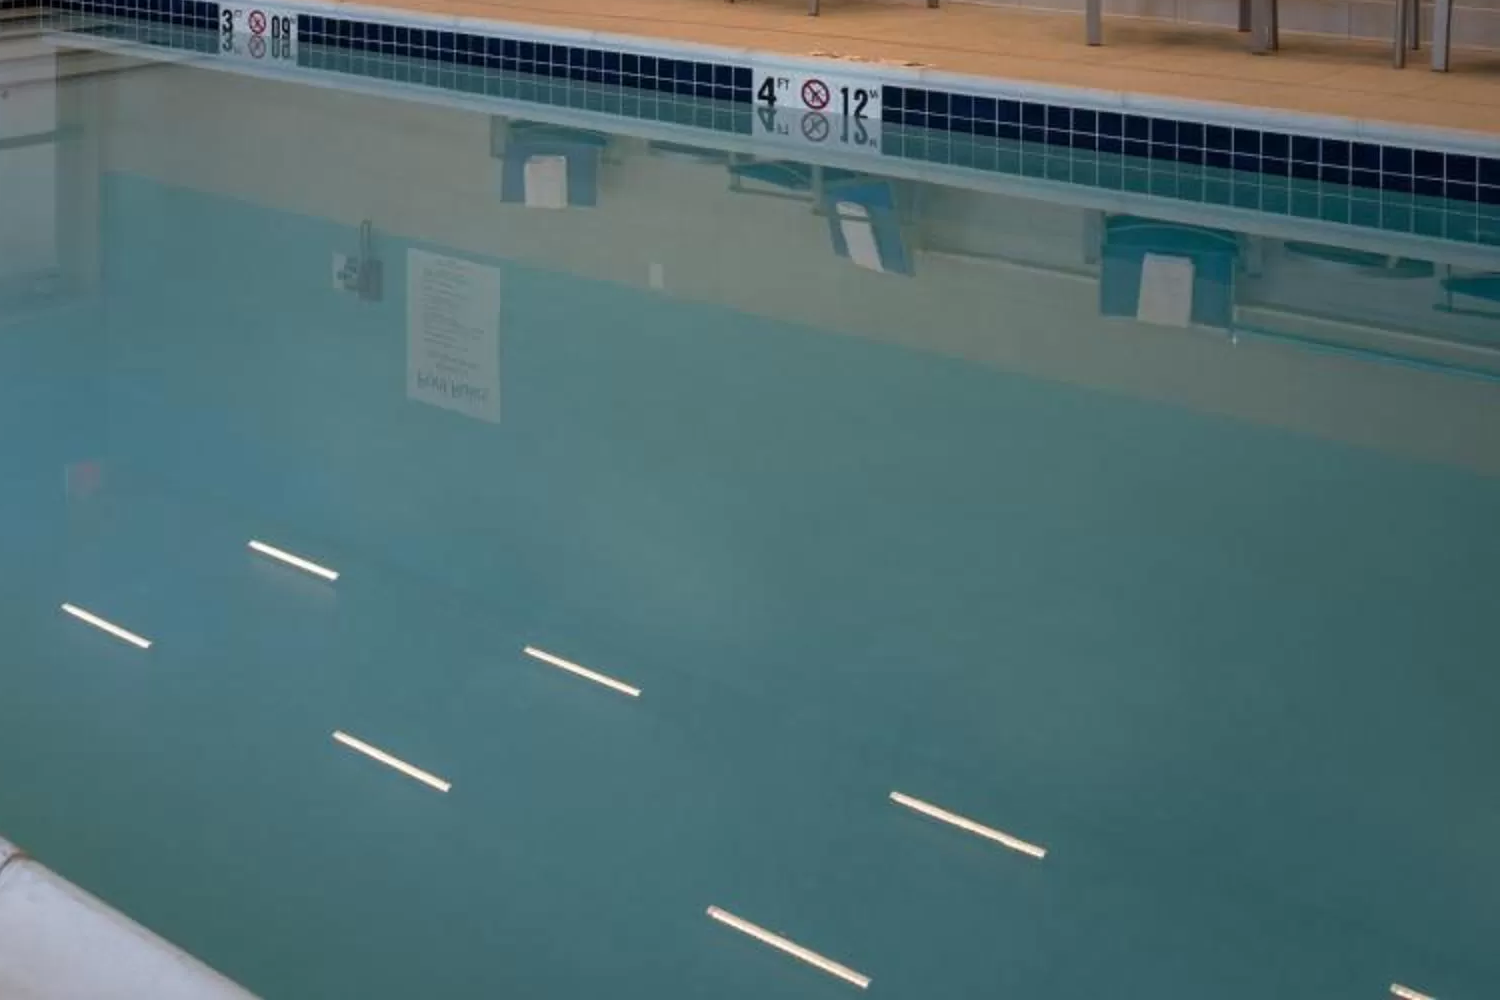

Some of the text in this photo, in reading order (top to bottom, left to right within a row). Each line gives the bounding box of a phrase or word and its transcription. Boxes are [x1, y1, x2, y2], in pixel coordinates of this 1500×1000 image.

[222, 9, 233, 32] 3
[758, 76, 777, 106] 4
[777, 77, 790, 91] FT
[840, 86, 869, 118] 12
